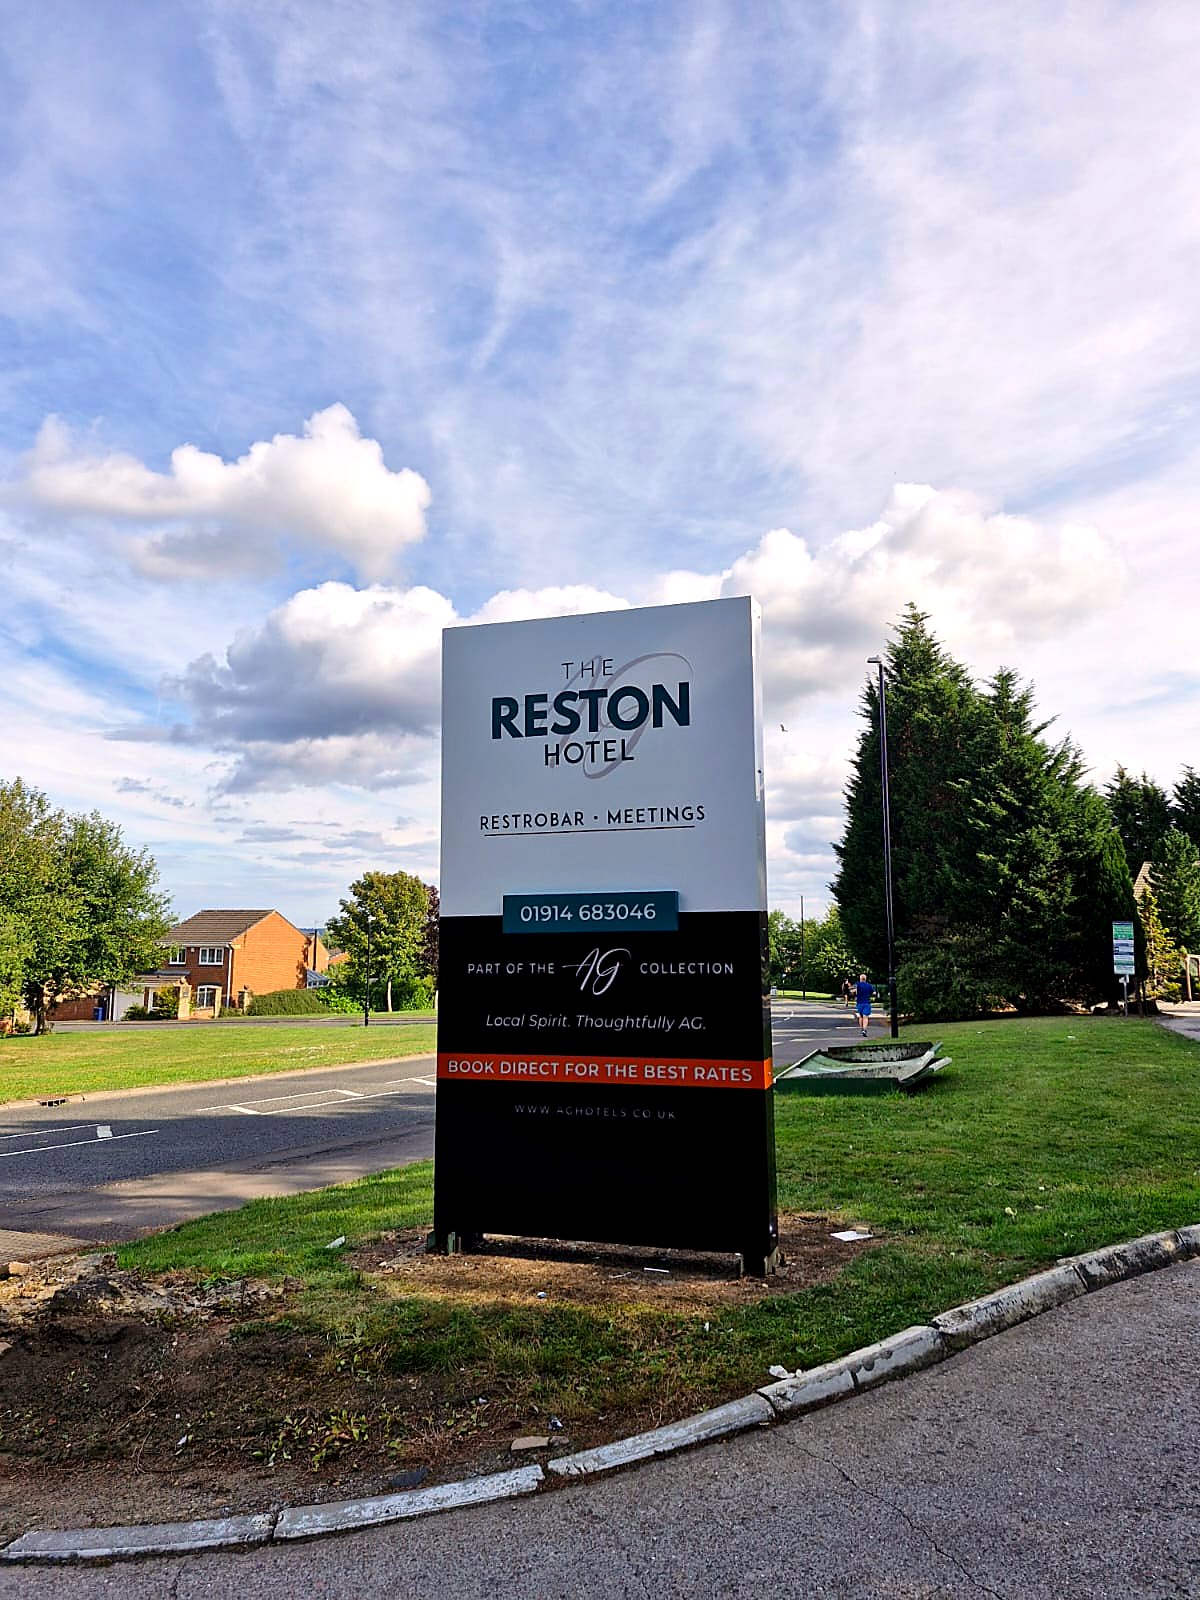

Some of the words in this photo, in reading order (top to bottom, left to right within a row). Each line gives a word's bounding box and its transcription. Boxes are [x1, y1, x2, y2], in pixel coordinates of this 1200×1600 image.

[561, 658, 614, 680] THE
[491, 681, 690, 740] RESTON
[544, 738, 635, 767] HOTEL
[480, 811, 585, 830] RESTROBAR
[607, 804, 706, 825] MEETINGS
[520, 904, 574, 923] 01914
[578, 902, 657, 922] 683046
[467, 962, 501, 975] PART
[505, 962, 524, 975] OF
[529, 962, 556, 975] THE
[639, 962, 735, 975] COLLECTION
[485, 1014, 526, 1028] Local
[528, 1013, 572, 1030] Spirit.
[576, 1014, 676, 1033] Thoughtfully
[678, 1016, 707, 1031] AG.
[448, 1059, 495, 1074] BOOK
[500, 1061, 560, 1076] DIRECT
[565, 1063, 600, 1077] FOR
[604, 1063, 639, 1079] THE
[643, 1065, 688, 1081] BEST
[693, 1066, 753, 1082] RATES
